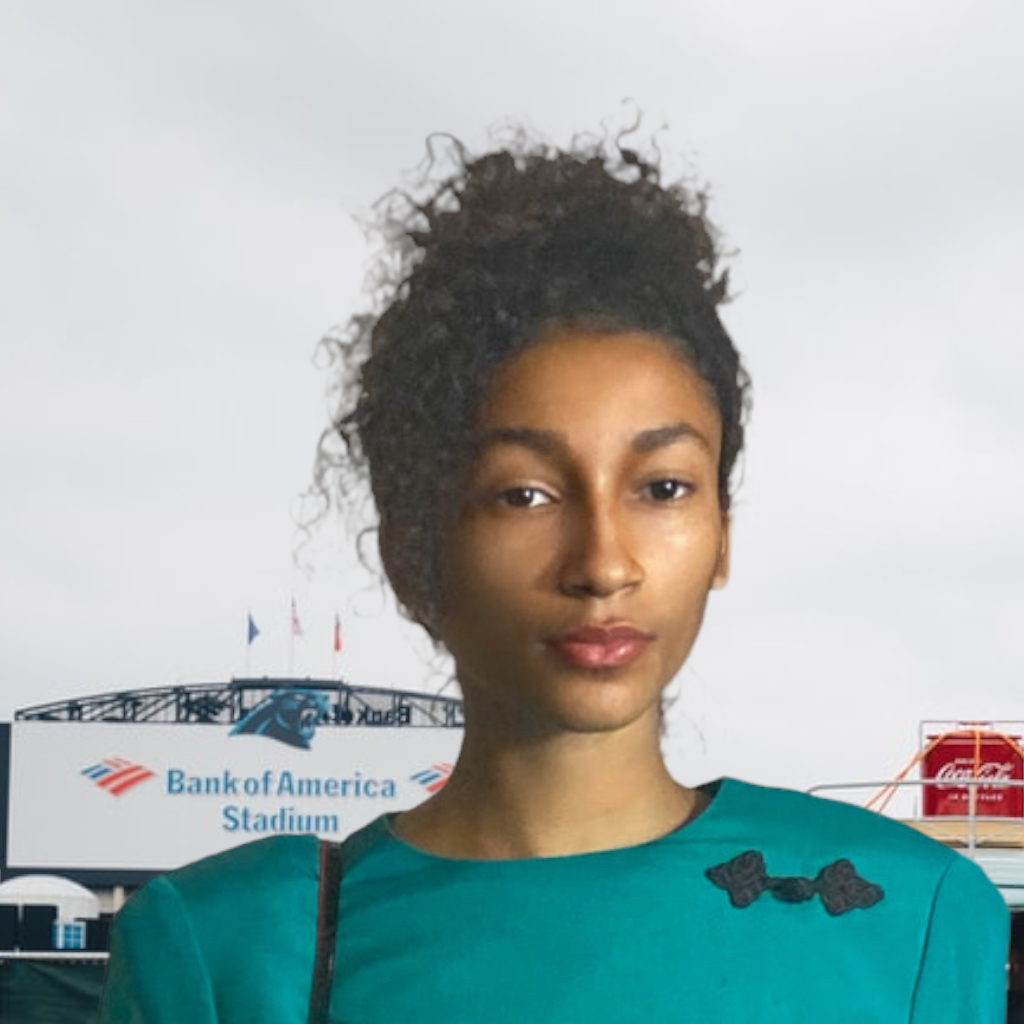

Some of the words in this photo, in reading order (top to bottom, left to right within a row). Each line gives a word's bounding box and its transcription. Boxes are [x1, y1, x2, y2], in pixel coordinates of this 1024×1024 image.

[167, 769, 237, 795] Bank
[244, 770, 272, 796] of
[278, 771, 396, 798] America
[935, 761, 1014, 790] CocaCola
[223, 805, 338, 832] Stadium
